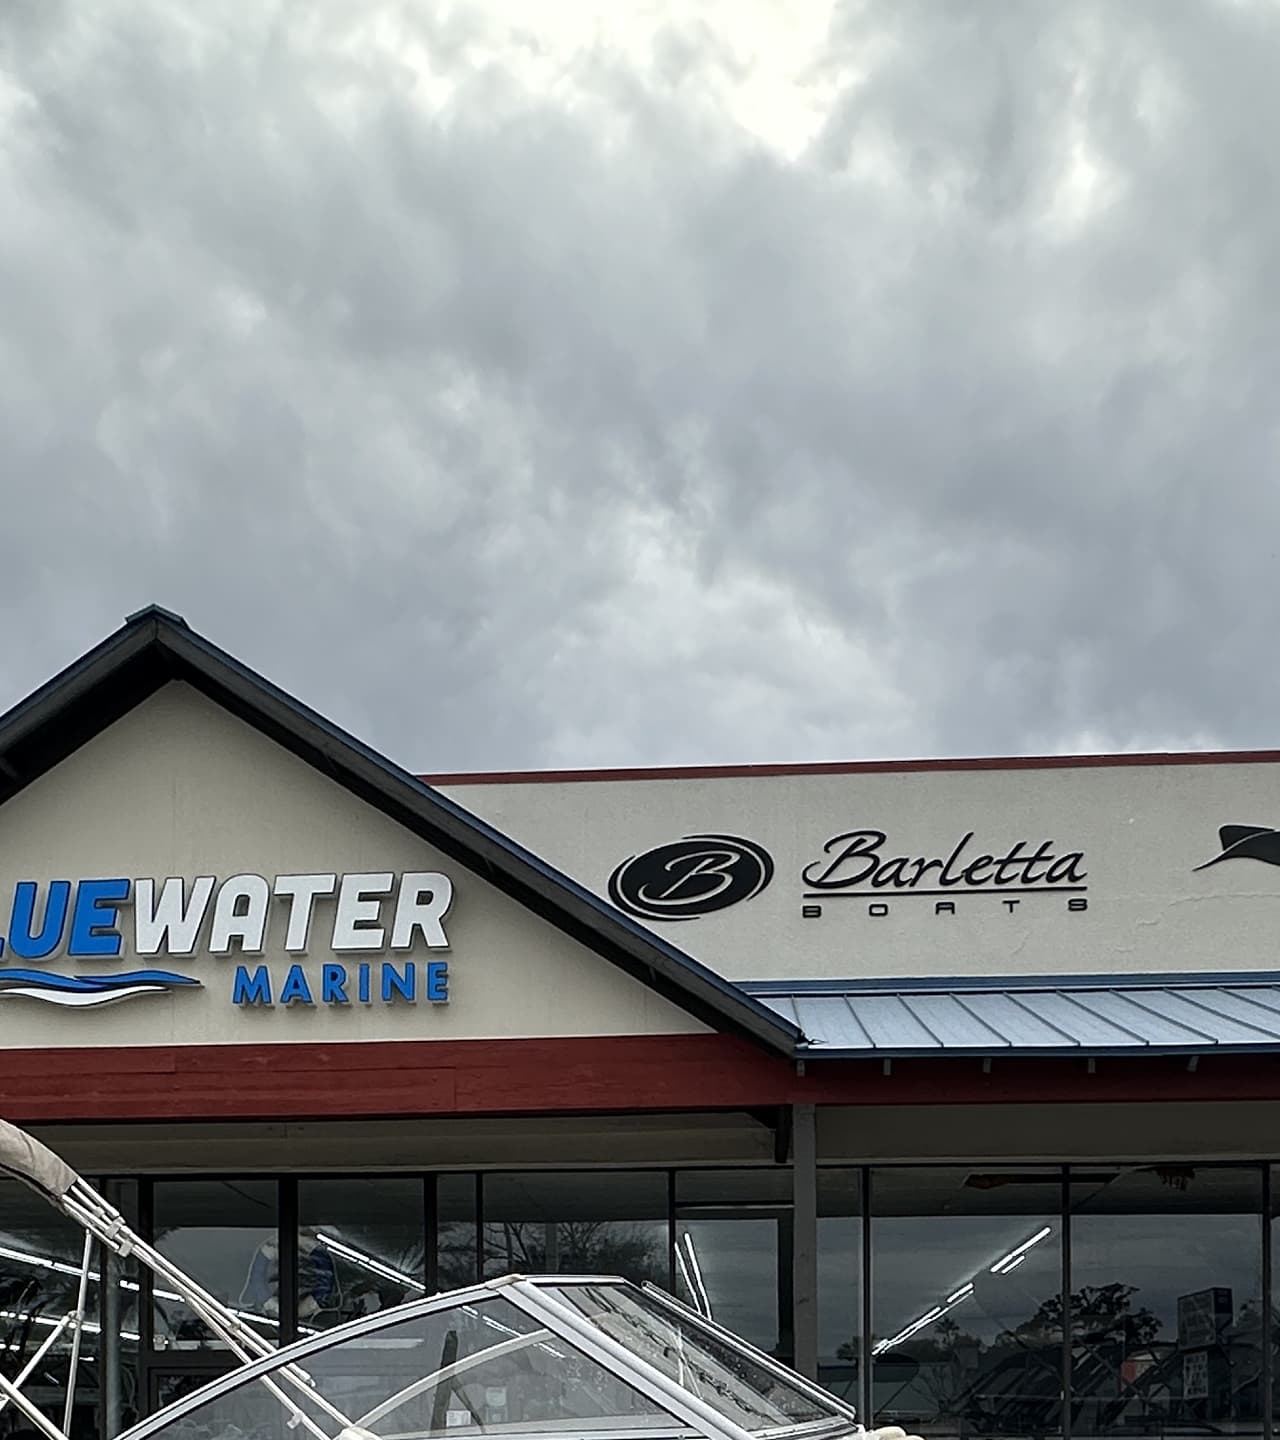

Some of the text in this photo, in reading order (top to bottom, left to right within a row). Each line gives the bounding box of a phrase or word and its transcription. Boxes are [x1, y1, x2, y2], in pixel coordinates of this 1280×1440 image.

[801, 830, 1088, 889] Barletta
[802, 898, 1088, 918] BOATS
[231, 961, 449, 1008] MARINE
